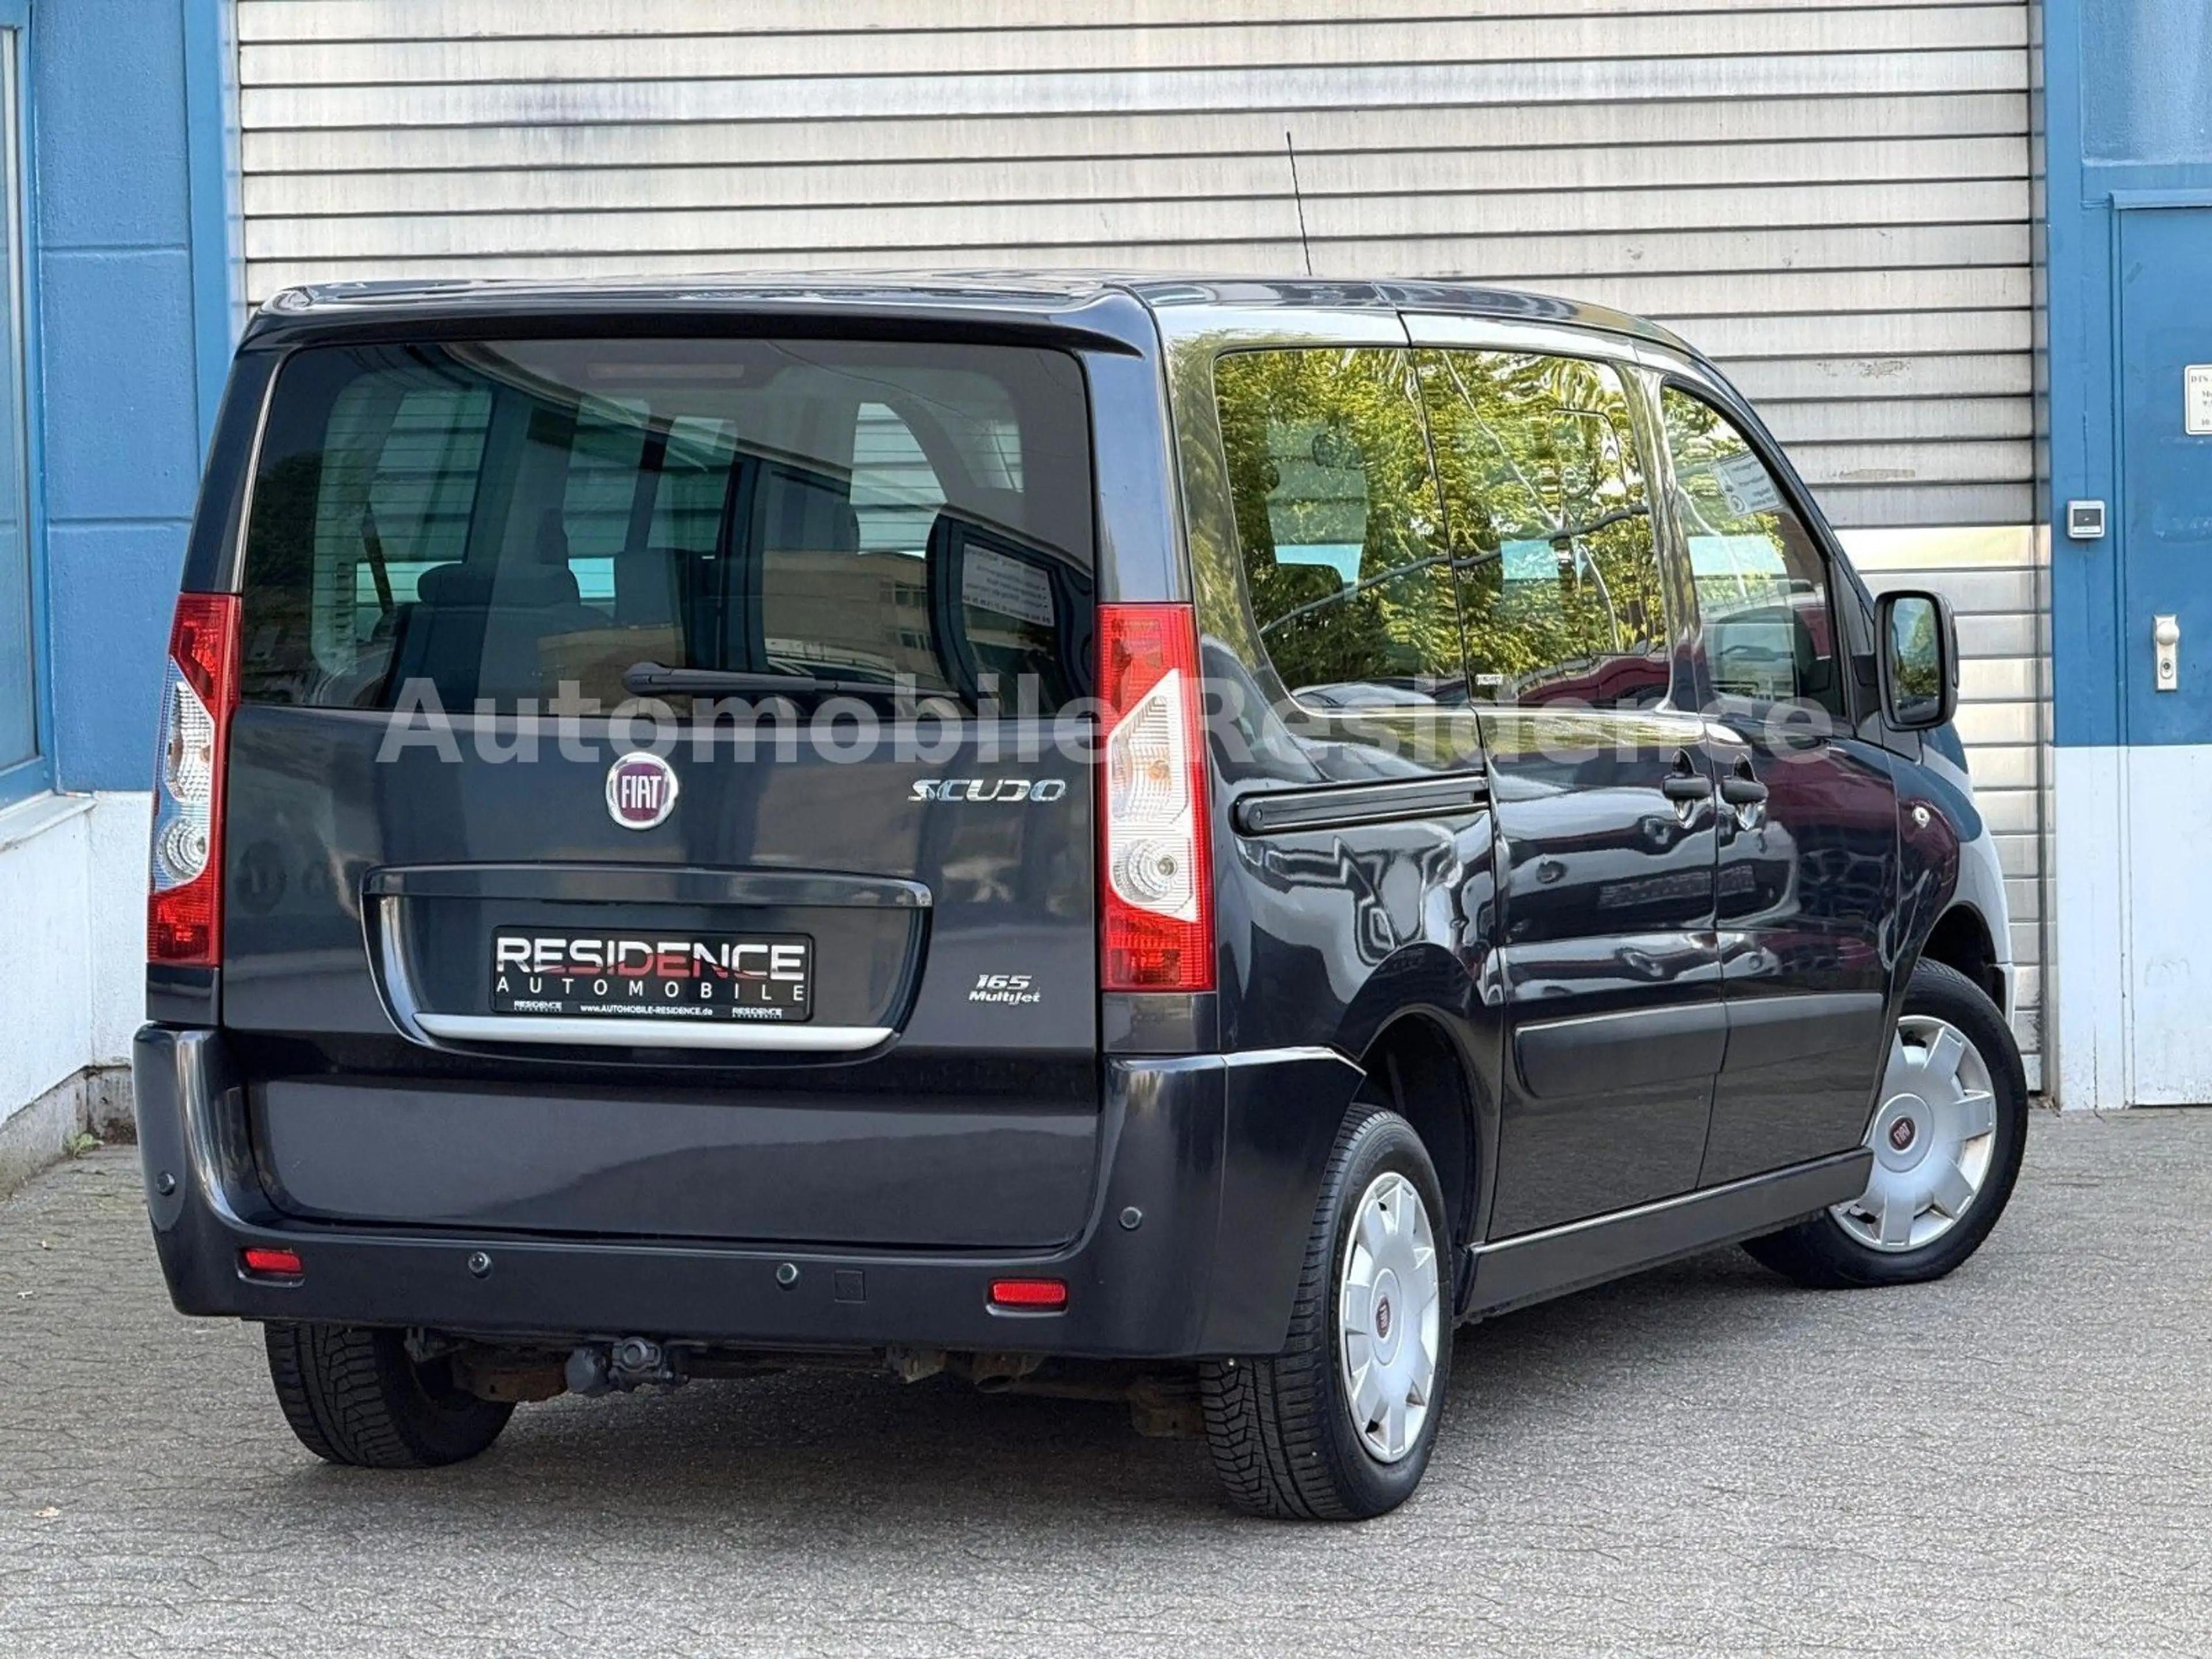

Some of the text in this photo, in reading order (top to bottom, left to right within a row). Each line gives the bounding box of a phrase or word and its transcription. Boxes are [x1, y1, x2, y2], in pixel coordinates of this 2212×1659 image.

[622, 775, 662, 809] FIAT
[907, 779, 1066, 802] SCUDO
[496, 937, 805, 981] RESIDENCE
[496, 977, 804, 1001] AUTOMOBILE
[976, 974, 1032, 990] 165
